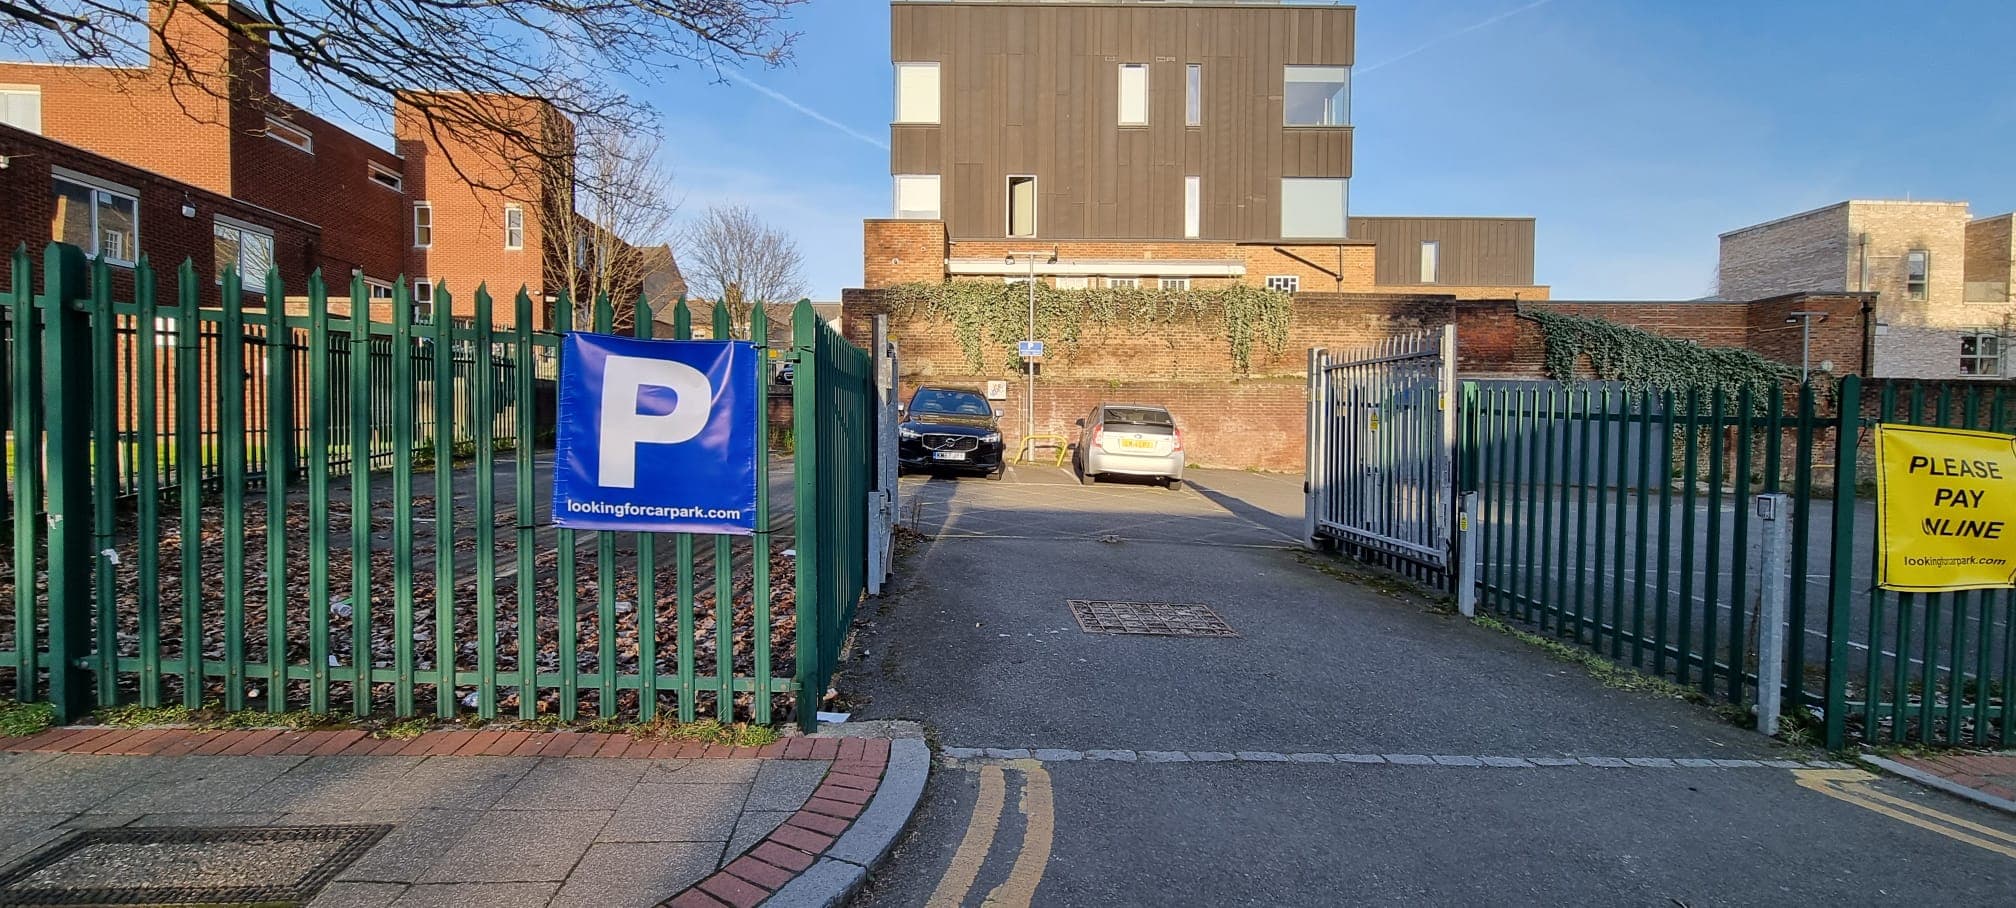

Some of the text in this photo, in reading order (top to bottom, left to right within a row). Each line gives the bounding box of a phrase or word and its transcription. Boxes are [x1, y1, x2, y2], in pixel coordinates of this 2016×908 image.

[599, 355, 712, 489] P
[1909, 456, 2004, 480] PLEASE
[567, 499, 741, 520] lookingforcarpark.com
[1934, 488, 1985, 509] PAY
